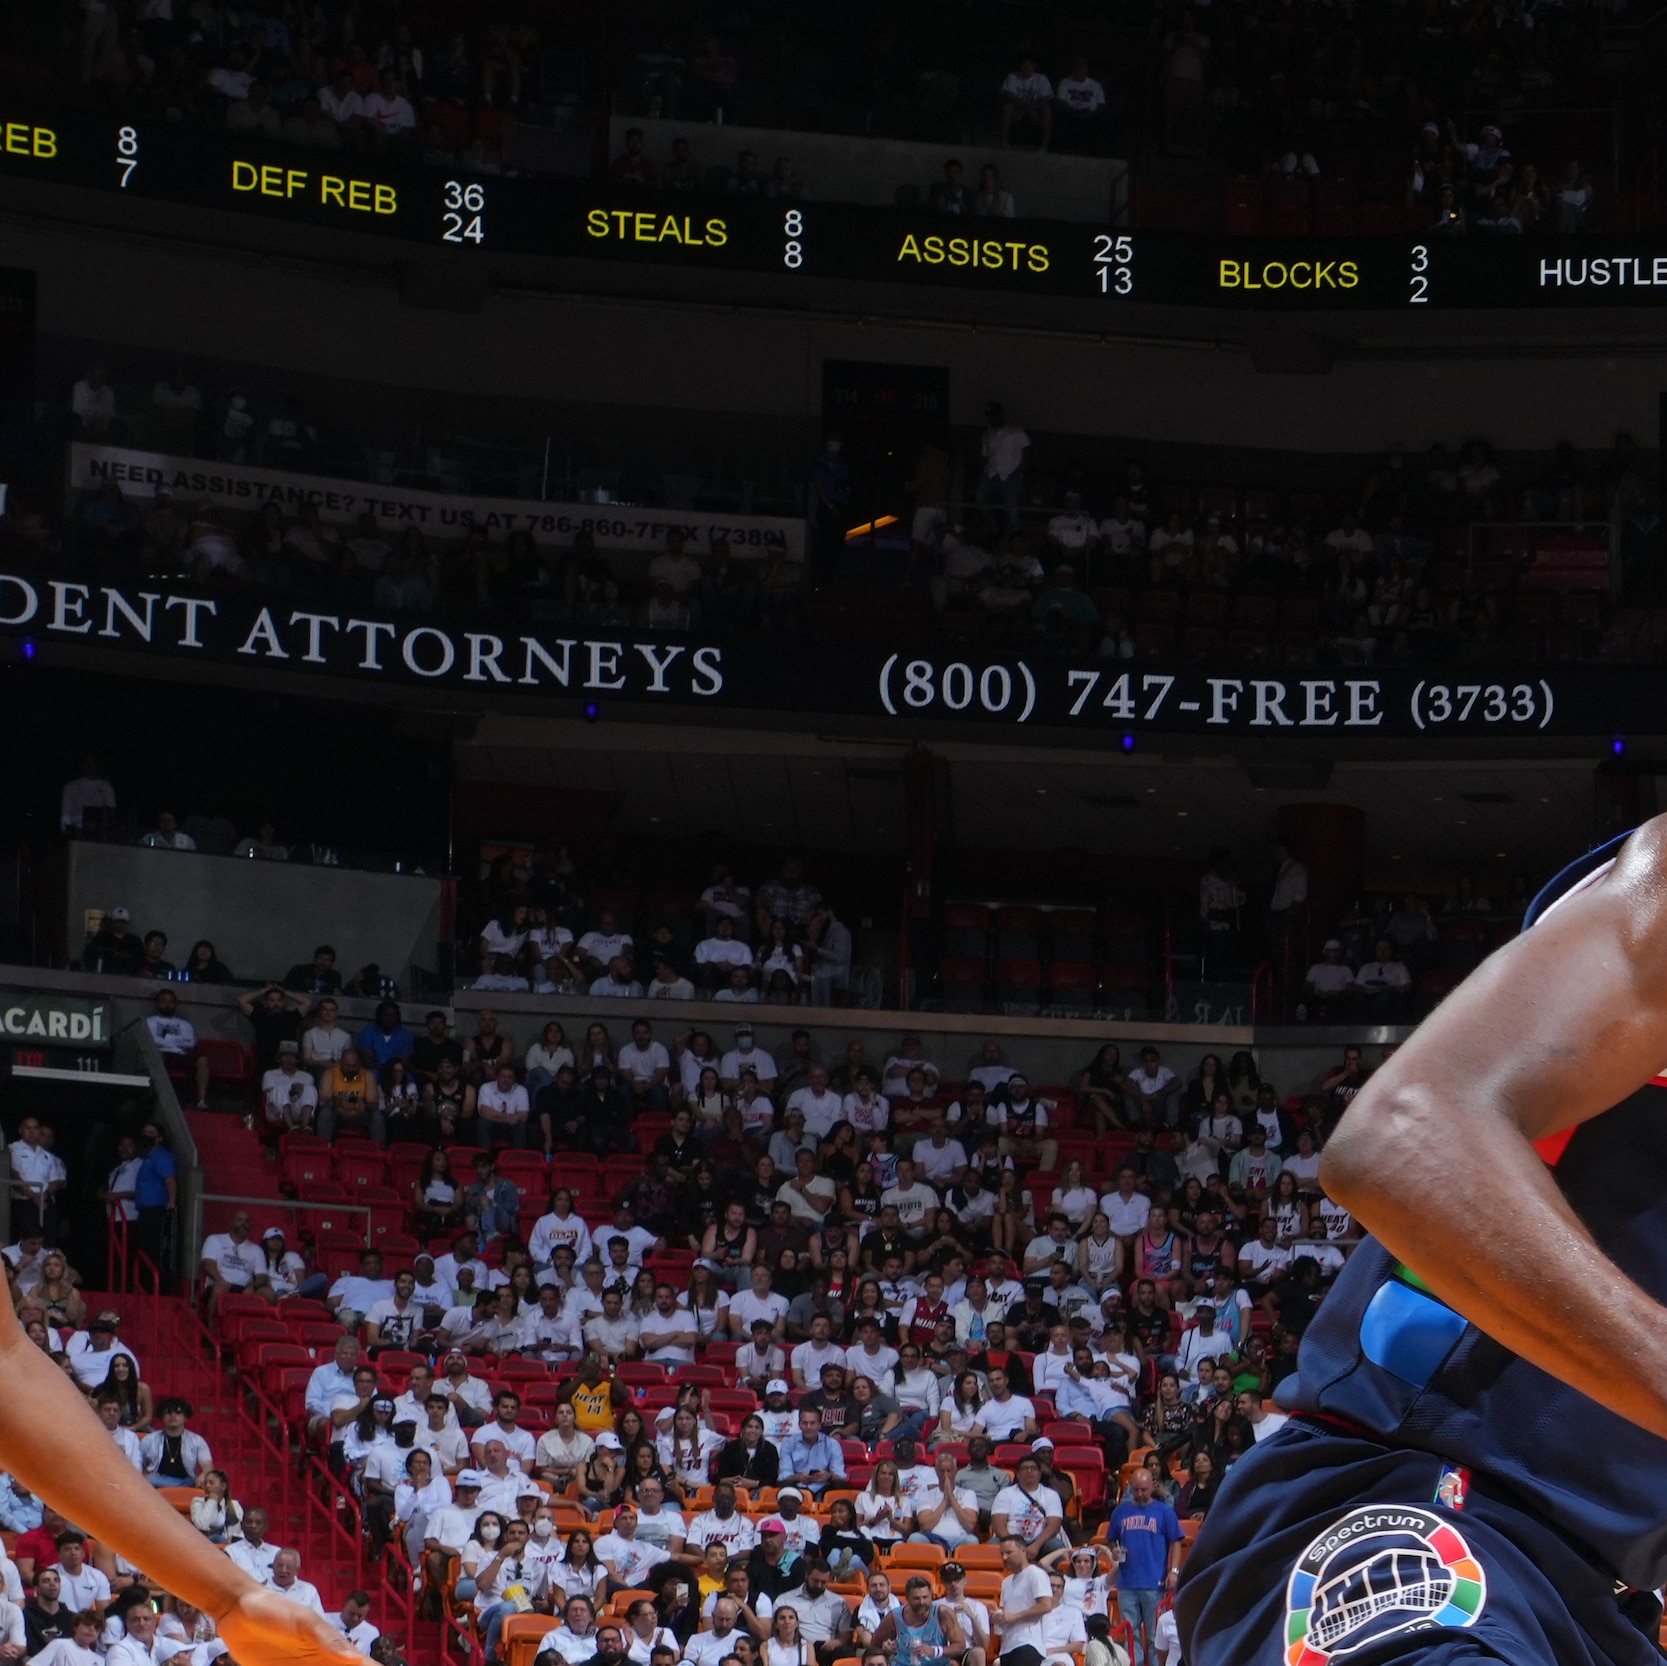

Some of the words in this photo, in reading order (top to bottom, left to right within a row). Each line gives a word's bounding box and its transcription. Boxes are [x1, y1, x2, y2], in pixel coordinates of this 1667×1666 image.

[0, 121, 57, 159] EB
[117, 126, 138, 155] 8
[116, 159, 137, 189] 7
[232, 161, 307, 199] DEF
[321, 174, 398, 215] REB
[444, 181, 485, 212] 36
[443, 213, 485, 244] 24
[586, 209, 728, 247] STEALS
[784, 210, 803, 238] 8
[784, 241, 803, 269] 8
[897, 235, 1051, 272] ASSISTS
[1093, 235, 1133, 263] 25
[1410, 246, 1429, 272] 3
[1095, 265, 1133, 294] 13
[1219, 260, 1359, 289] BLOCKS
[1409, 275, 1429, 303] 2
[90, 460, 163, 484] NEED
[171, 471, 355, 513] ASSISTANCE?
[363, 497, 432, 522] TEXT
[441, 508, 475, 527] US
[485, 512, 517, 530] AT
[0, 574, 217, 649] DENT
[237, 607, 725, 697] ATTORNEYS
[879, 652, 1037, 724] (800)
[1067, 669, 1383, 728] 747-FREE
[1410, 680, 1556, 730] (3733)
[705, 1532, 739, 1543] HEAT
[1308, 1513, 1426, 1564] Spectrum
